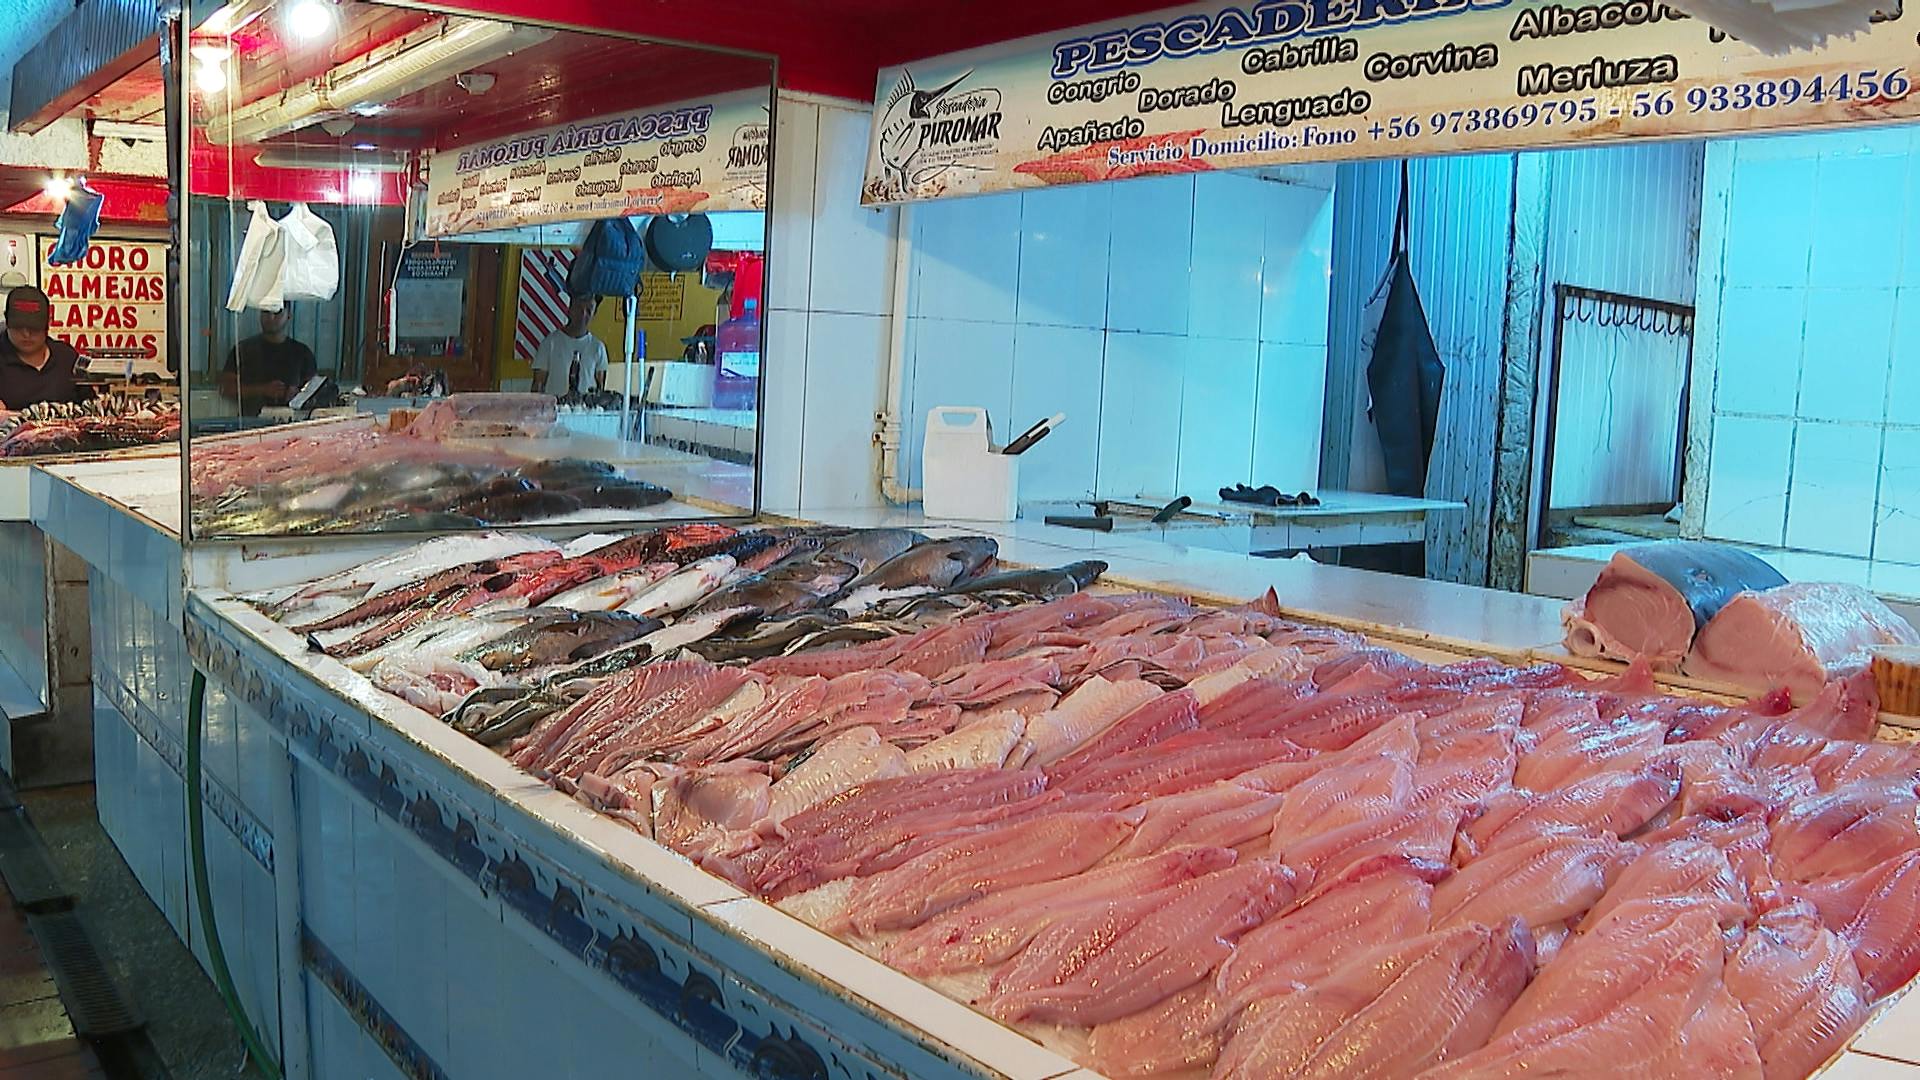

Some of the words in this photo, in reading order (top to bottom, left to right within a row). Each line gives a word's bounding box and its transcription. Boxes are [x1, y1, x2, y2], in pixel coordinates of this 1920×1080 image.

[1241, 36, 1360, 74] Cabrilla
[1363, 42, 1499, 82] Corvina
[1048, 71, 1141, 104] Congrio
[1517, 55, 1679, 97] Merluza
[1138, 78, 1236, 112] Dorado
[1221, 87, 1372, 127] Lenguado
[919, 112, 1002, 149] PUROMAR
[1037, 116, 1144, 151] Apañado
[1107, 141, 1184, 166] Servicio
[1190, 130, 1298, 158] Domicilio:
[1302, 126, 1357, 148] Fono
[1367, 114, 1421, 142] +56
[1430, 97, 1597, 135] 973869795
[1632, 90, 1674, 118] 56
[1687, 67, 1908, 114] 933894456
[48, 243, 149, 271] ORO
[48, 274, 164, 300] ALMEJAS
[49, 304, 138, 330] LAPAS
